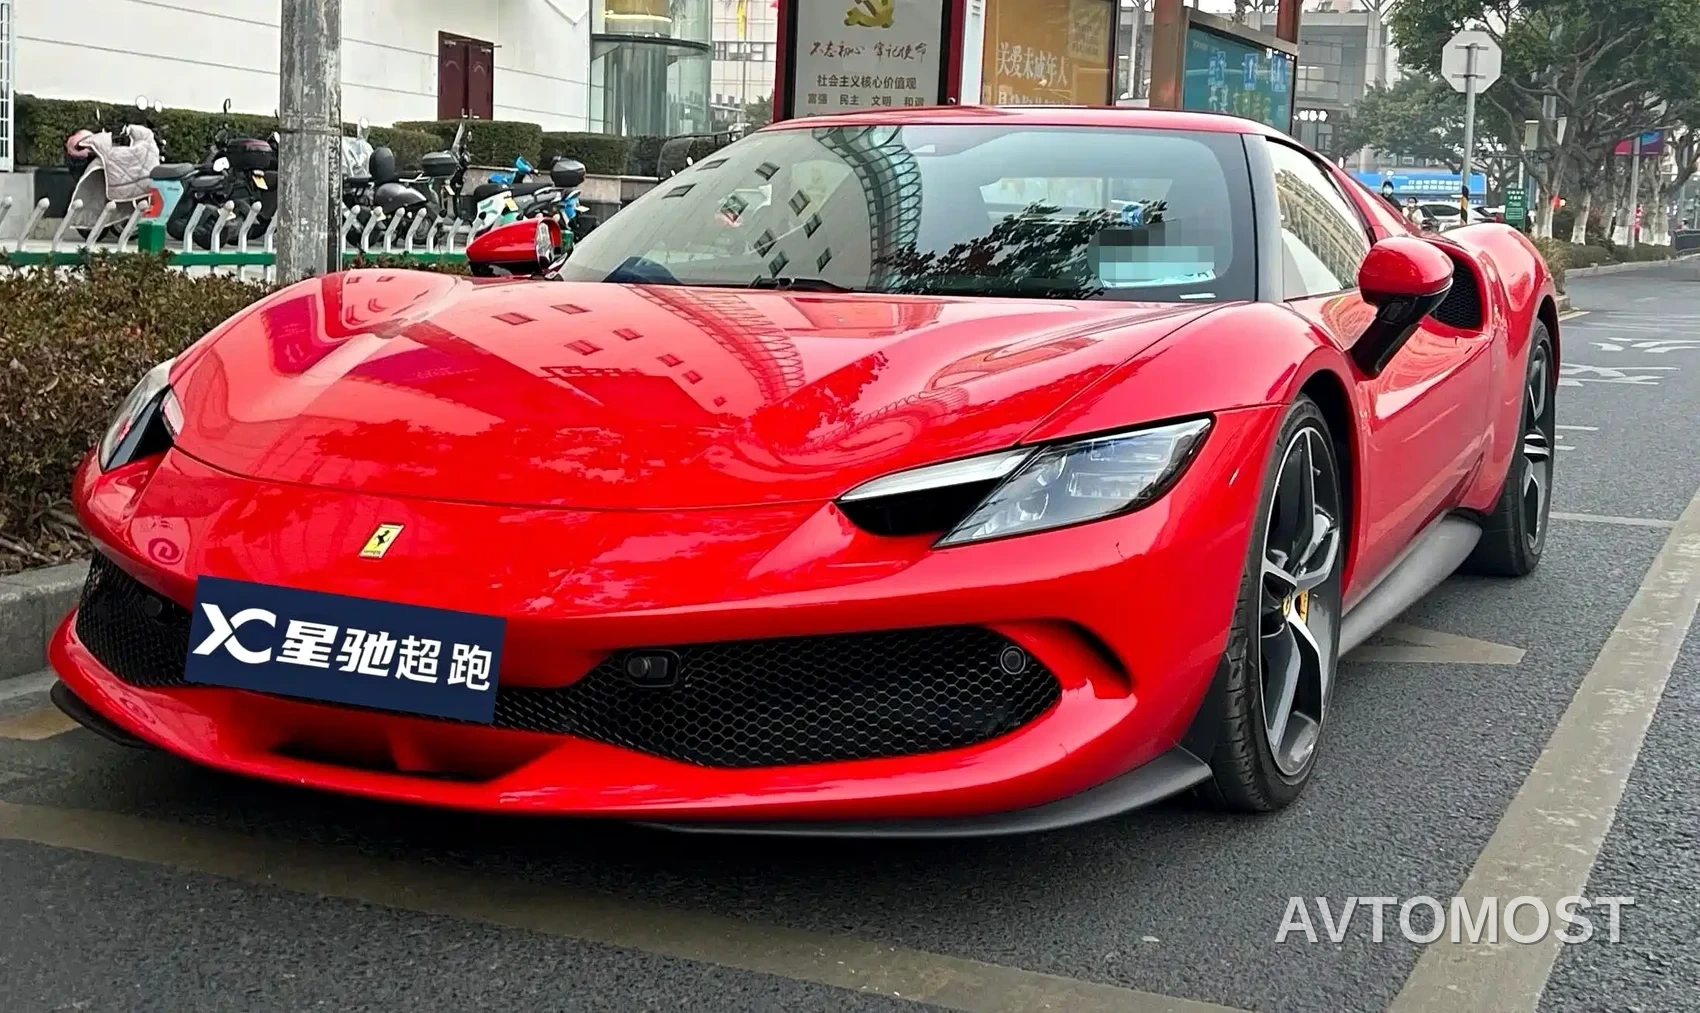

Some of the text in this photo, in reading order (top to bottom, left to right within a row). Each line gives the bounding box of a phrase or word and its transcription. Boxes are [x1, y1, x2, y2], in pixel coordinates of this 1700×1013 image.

[810, 41, 928, 63] 不忘初心 牢记使命
[817, 75, 917, 89] 社会主义核心价值观
[839, 95, 860, 106] 民主
[871, 96, 892, 107] 文明
